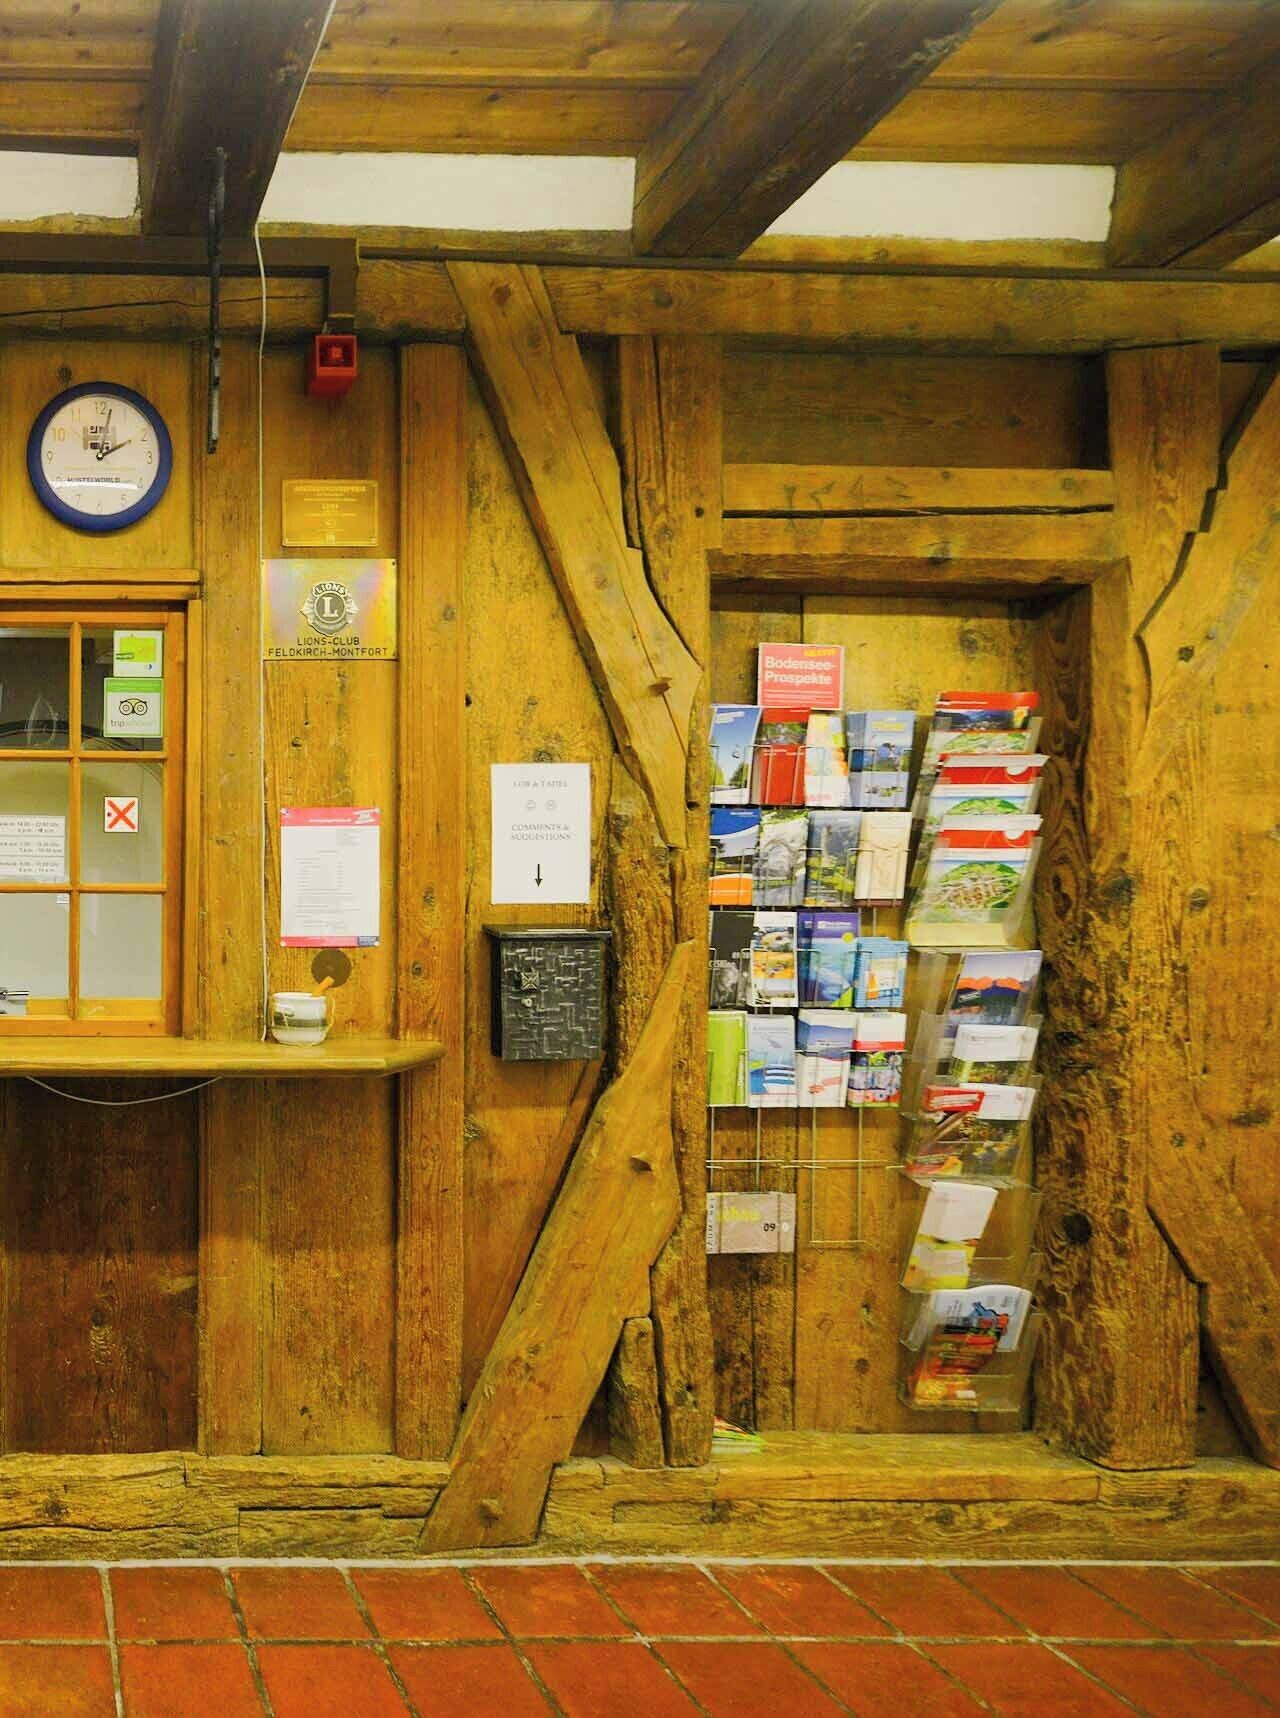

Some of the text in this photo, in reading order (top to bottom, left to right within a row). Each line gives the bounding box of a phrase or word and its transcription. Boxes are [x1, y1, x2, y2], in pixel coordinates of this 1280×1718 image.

[94, 401, 107, 415] 12
[145, 450, 153, 464] 3
[315, 582, 346, 595] LIONS
[321, 596, 339, 618] L
[297, 637, 360, 646] LIONS-CLUB
[268, 647, 388, 657] FELDKIRCH-MONTFORT
[765, 656, 838, 671] Bodensee-
[764, 670, 833, 687] Prospekte
